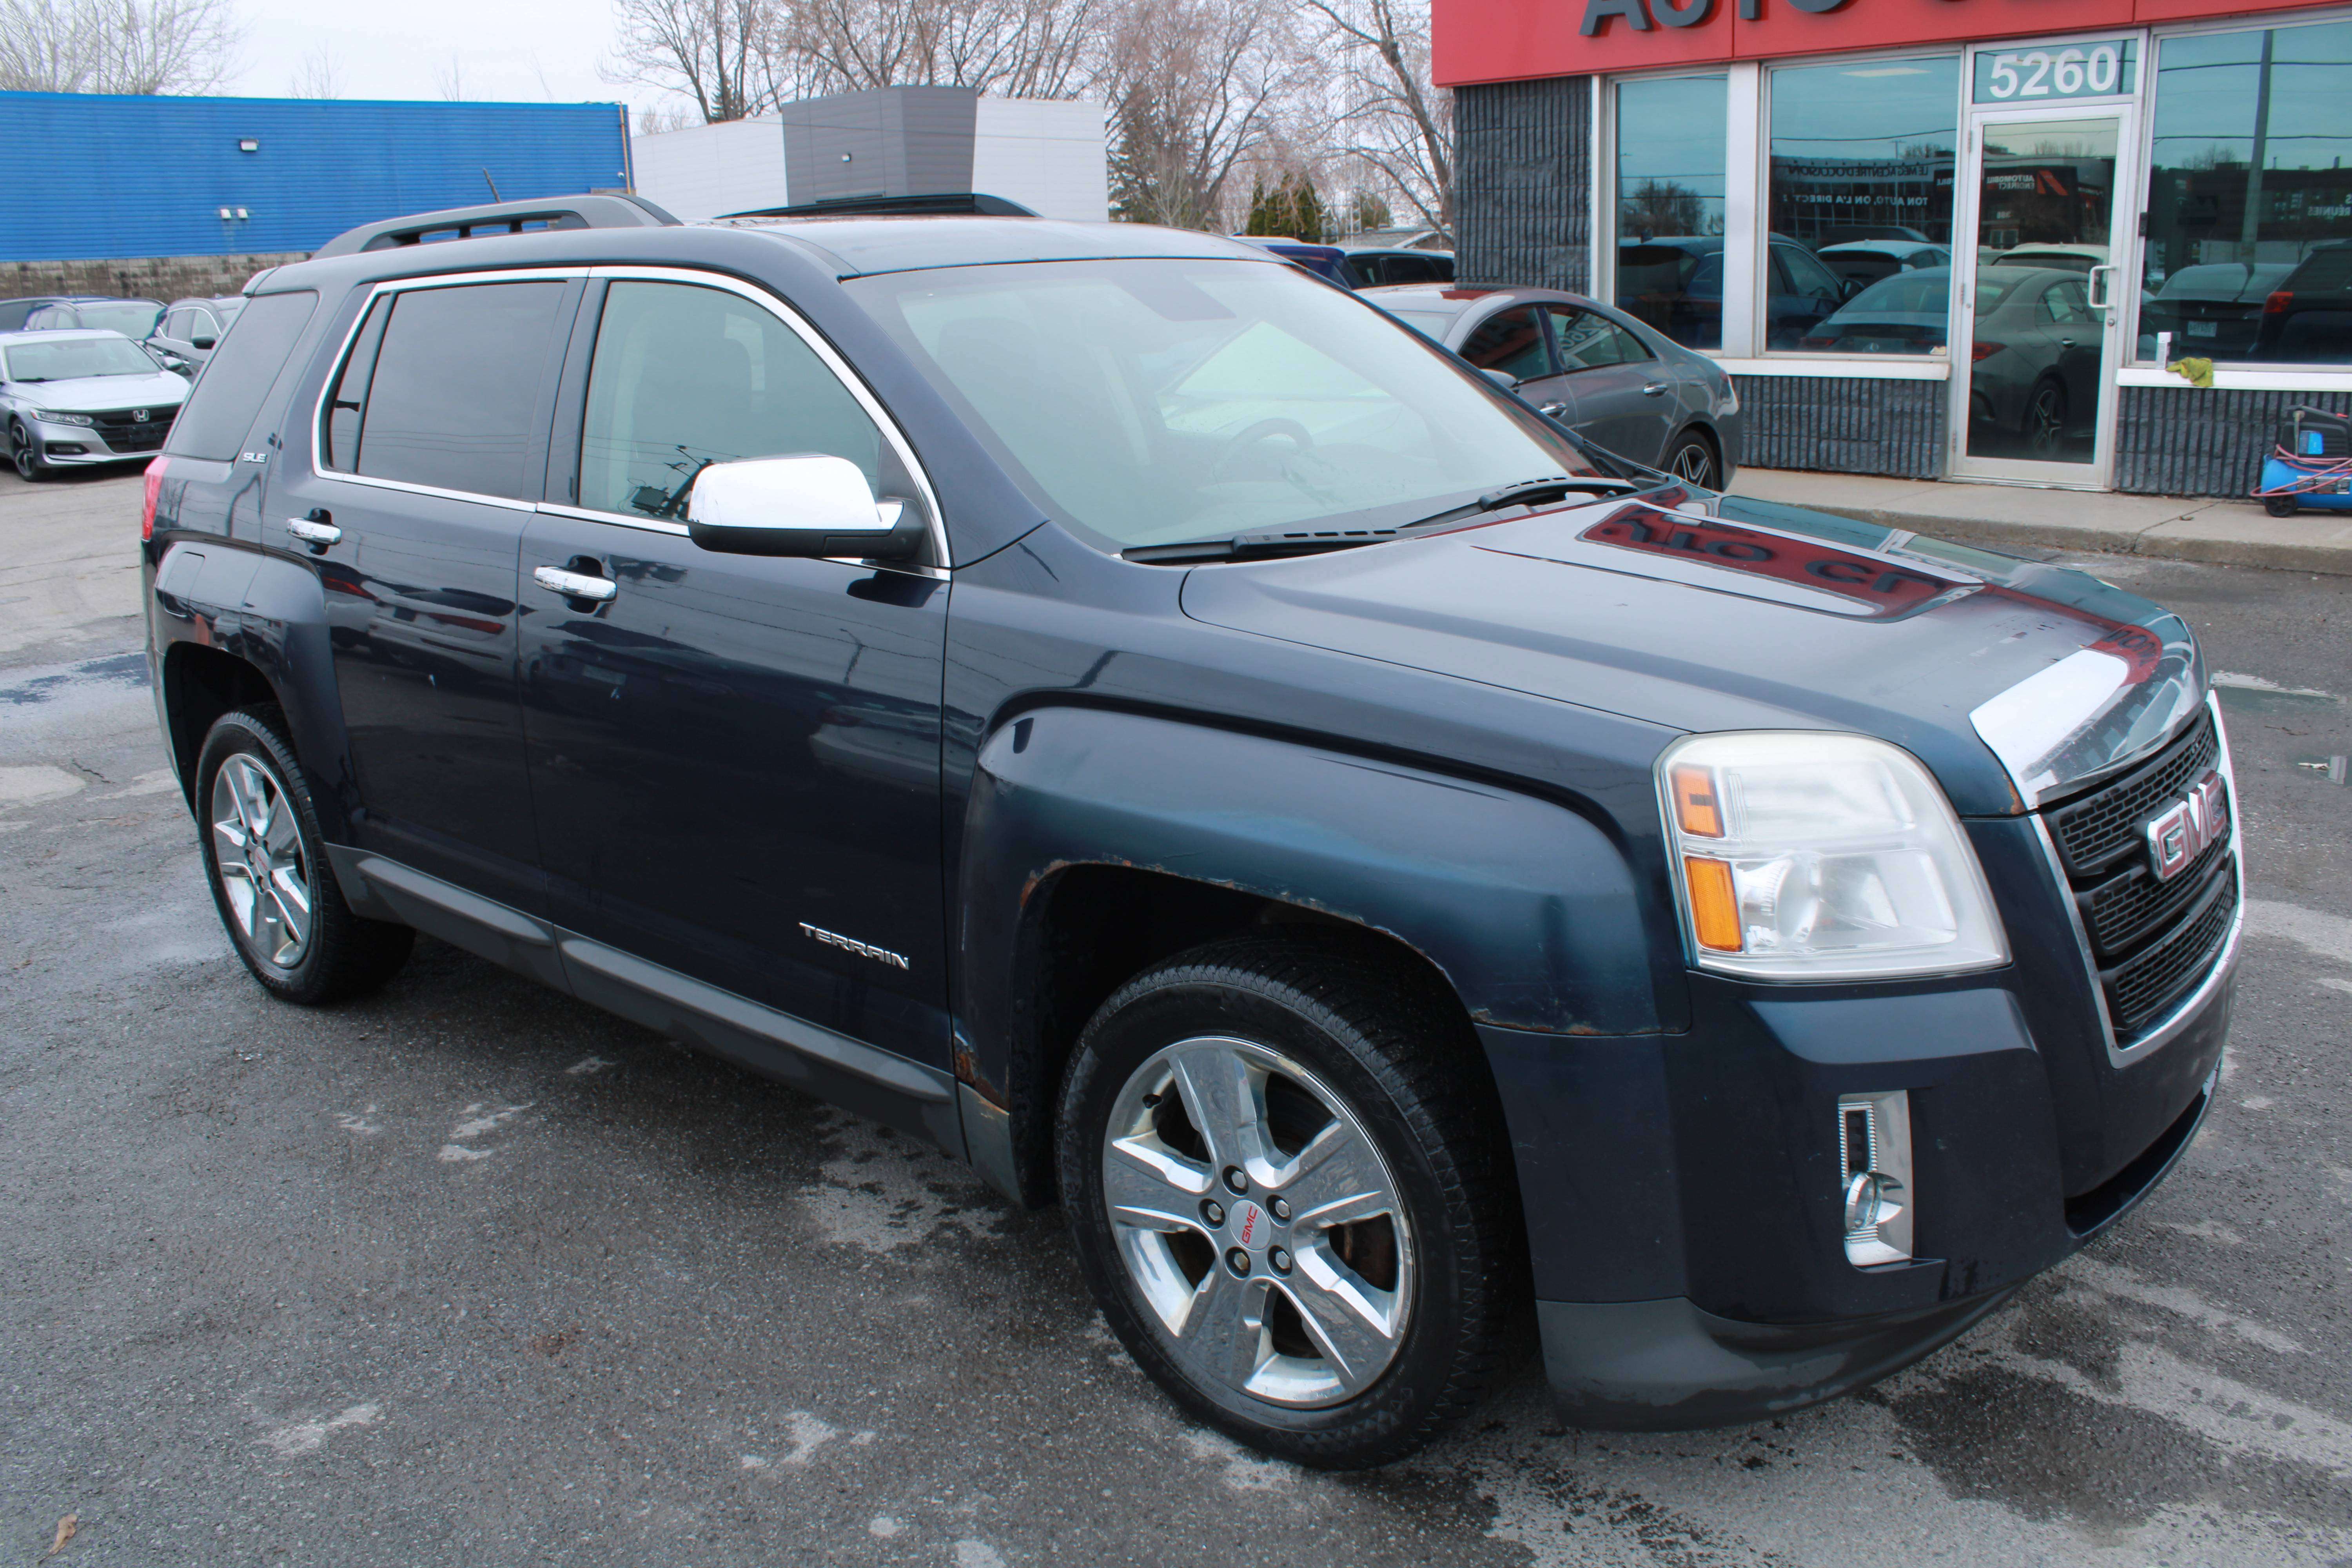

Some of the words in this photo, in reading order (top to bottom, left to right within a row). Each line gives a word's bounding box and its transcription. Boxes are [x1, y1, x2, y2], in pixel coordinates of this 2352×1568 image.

[1989, 46, 2116, 98] 5260
[243, 452, 267, 464] SLE
[2147, 775, 2227, 882] GMC
[798, 922, 909, 970] TERRAIN
[1241, 1205, 1258, 1244] GMC
